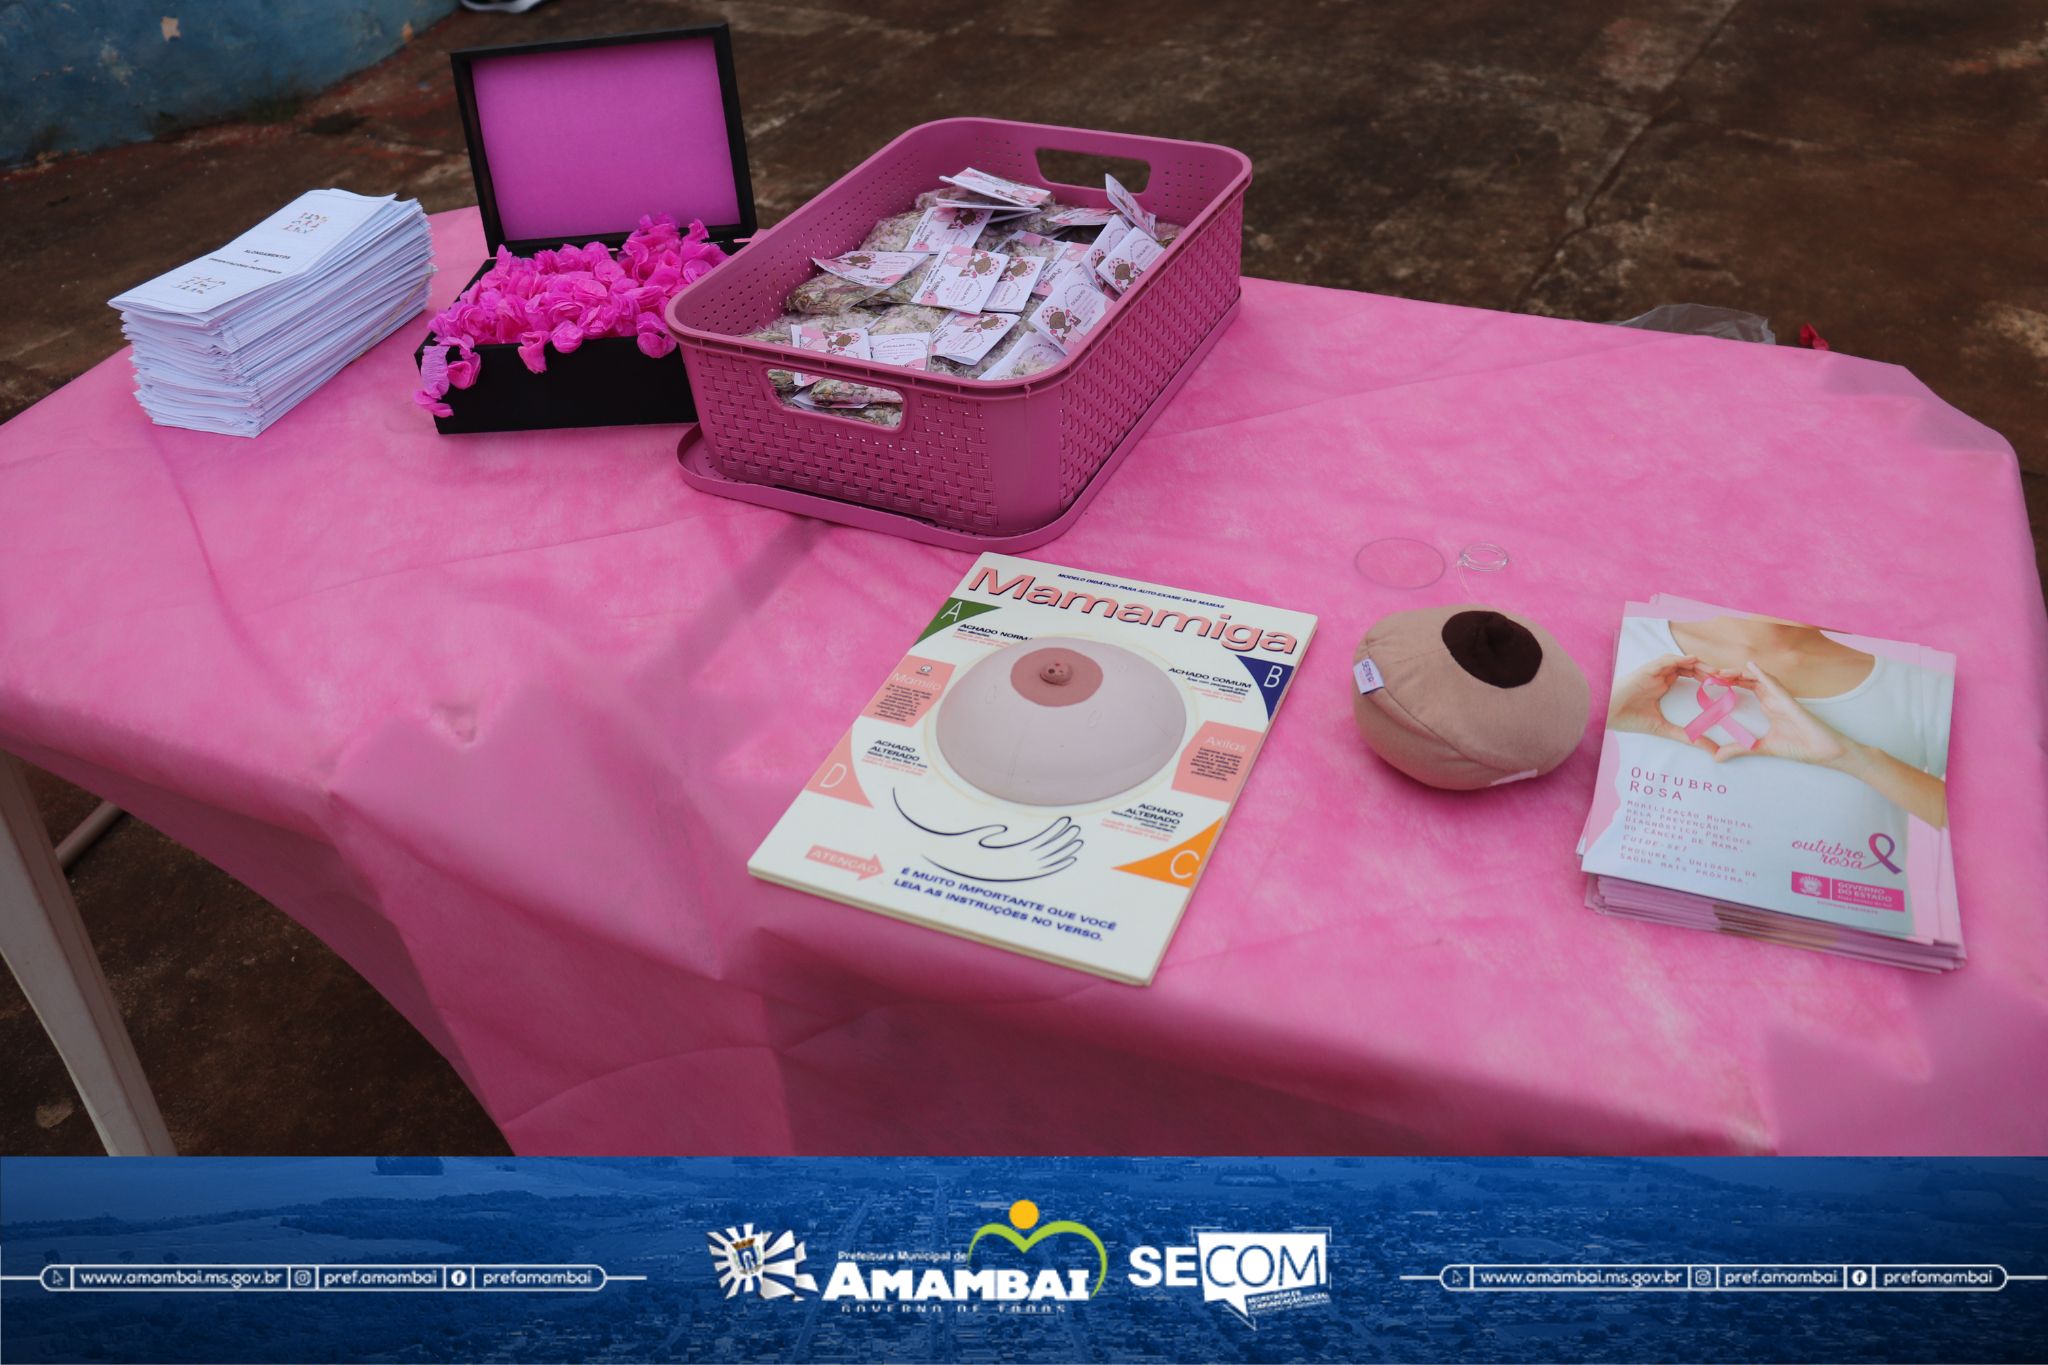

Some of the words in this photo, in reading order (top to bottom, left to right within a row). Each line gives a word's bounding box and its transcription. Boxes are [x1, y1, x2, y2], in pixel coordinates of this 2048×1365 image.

[1057, 573, 1086, 582] MODELO
[1137, 588, 1182, 600] AUTO-EXAME
[1198, 600, 1225, 609] MAMAS
[941, 601, 962, 621] A
[968, 567, 1297, 654] Mamamiga
[960, 623, 998, 635] ACHADO
[1168, 667, 1209, 680] ACHADO
[1212, 676, 1252, 689] COMUM
[1263, 665, 1283, 688] B
[870, 746, 920, 761] ALTERADO
[875, 740, 916, 753] ACHADO
[820, 763, 847, 788] D
[1631, 767, 1728, 794] OUTUBRO
[1630, 780, 1682, 801] ROSA
[1125, 808, 1180, 825] ALTERADO
[1139, 803, 1183, 818] ACHADO
[1791, 839, 1865, 859] outubro
[1170, 849, 1200, 879] C
[1822, 853, 1864, 870] rosa
[1838, 882, 1885, 895] GOVERNO
[1854, 891, 1893, 902] ESTADO
[901, 867, 910, 875] É
[912, 871, 955, 887] MUITO
[958, 883, 1045, 911] IMPORTANTE
[1047, 907, 1077, 920] QUE
[1080, 915, 1117, 931] VOCÊ
[894, 878, 921, 891] LEIA
[924, 888, 943, 897] AS
[945, 893, 1029, 920] INSTRUÇÕES
[1031, 916, 1052, 927] NO
[1057, 922, 1103, 941] VERSO.
